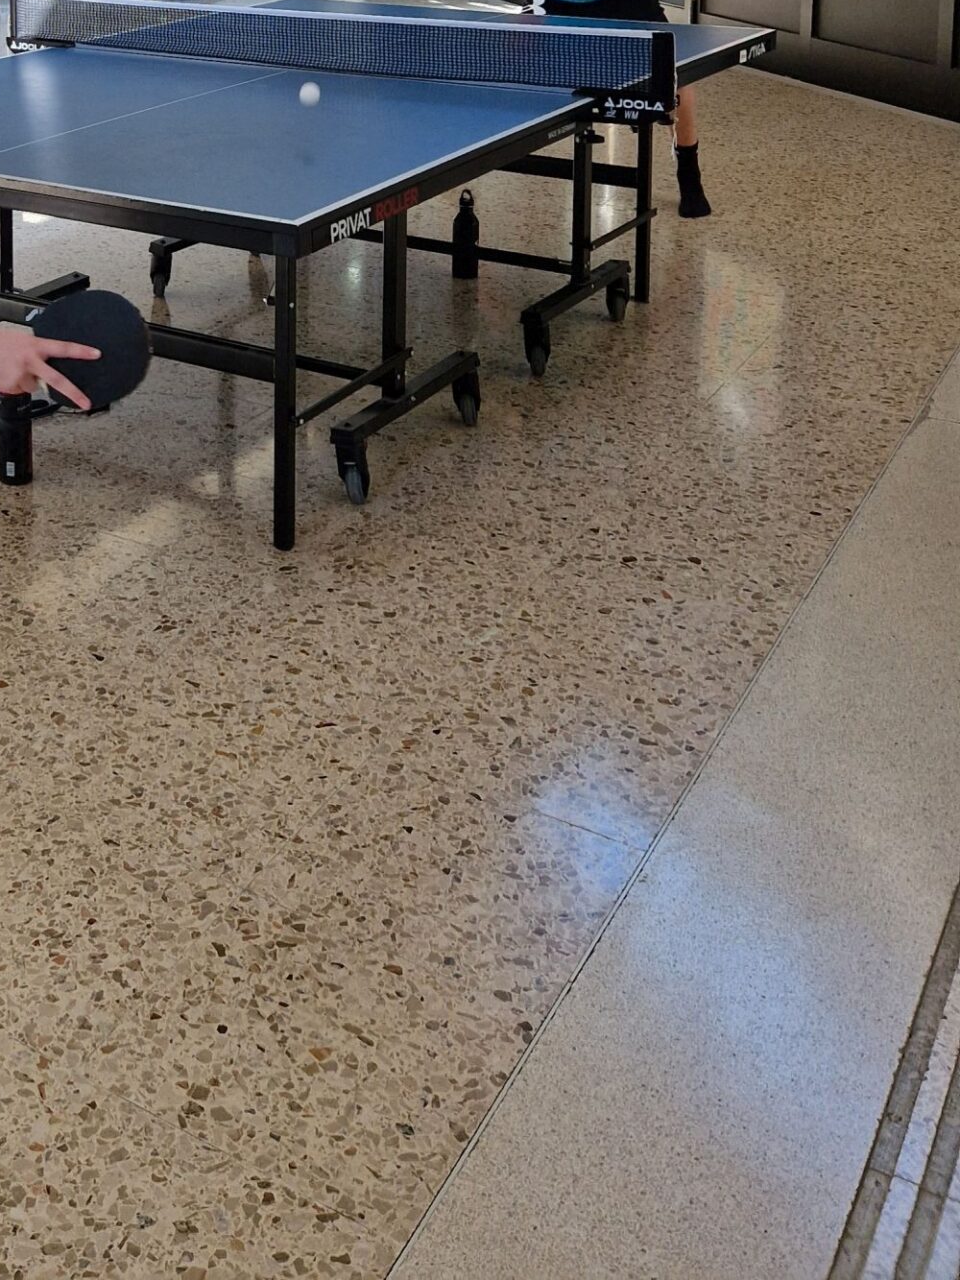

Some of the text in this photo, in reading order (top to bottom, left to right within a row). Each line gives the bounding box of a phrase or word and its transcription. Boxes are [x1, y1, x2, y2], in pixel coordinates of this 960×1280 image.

[615, 99, 665, 111] JOOLA
[624, 110, 639, 120] WM
[330, 186, 419, 245] PRIVAT ROLLER
